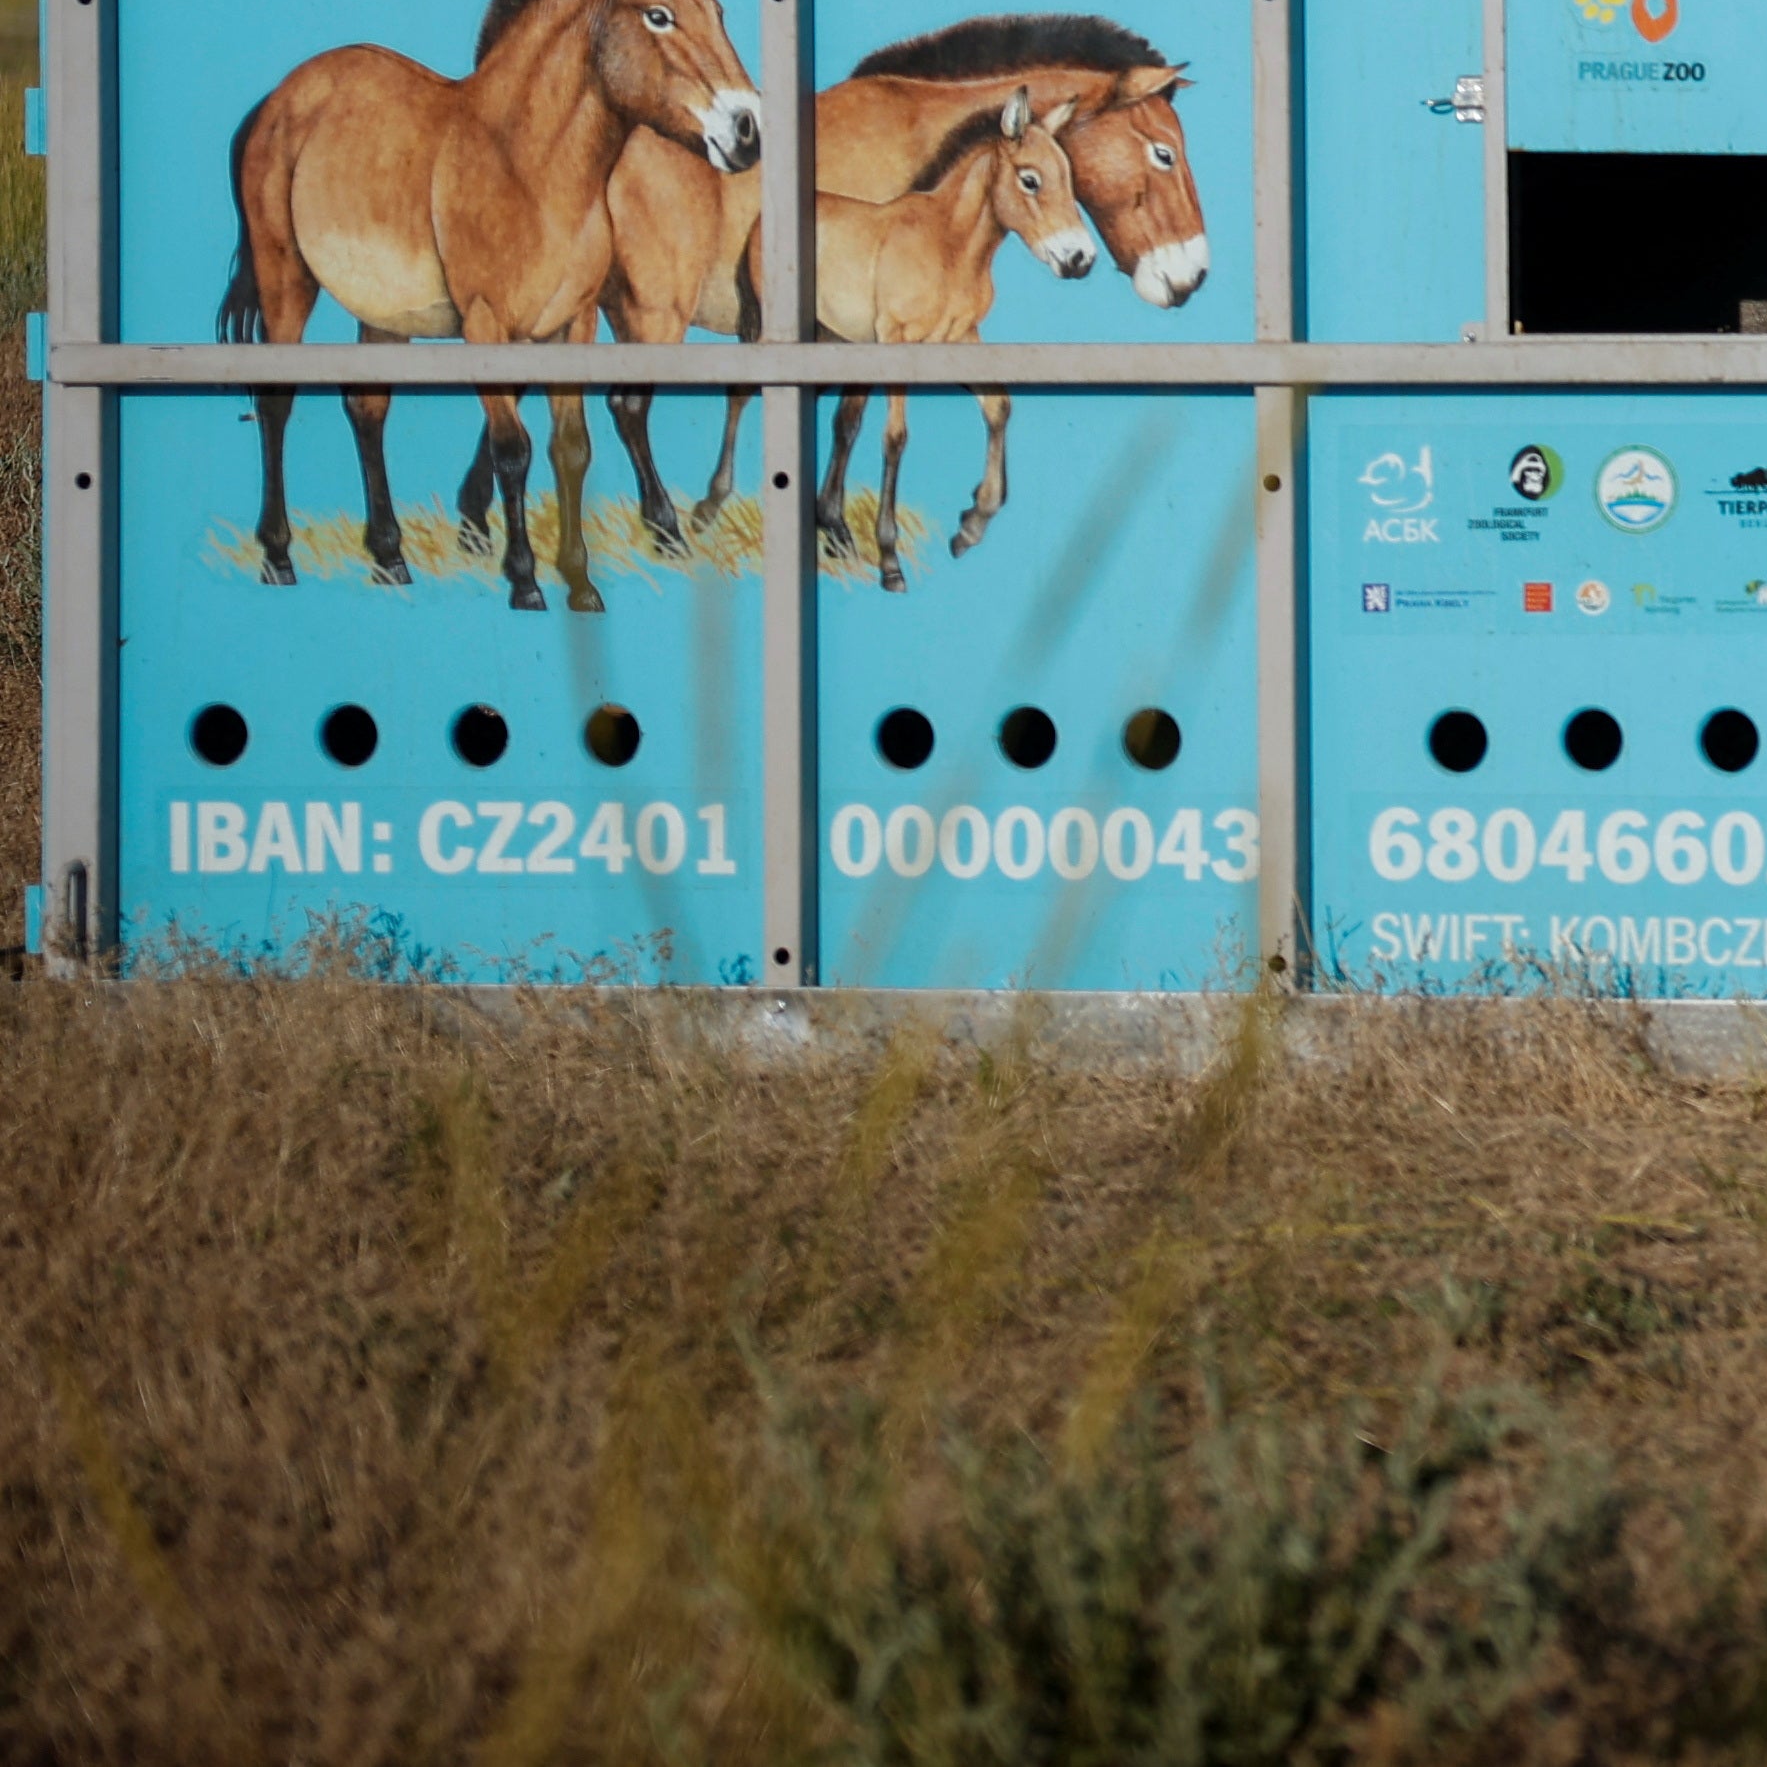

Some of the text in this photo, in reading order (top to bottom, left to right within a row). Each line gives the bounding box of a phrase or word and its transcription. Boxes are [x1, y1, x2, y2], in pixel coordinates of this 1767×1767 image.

[1578, 61, 1706, 82] PRAGUE ZOO
[1362, 517, 1440, 543] АСБК
[169, 801, 392, 873] IBAN:
[419, 800, 736, 875] CZ2401
[829, 803, 1260, 882] 00000043
